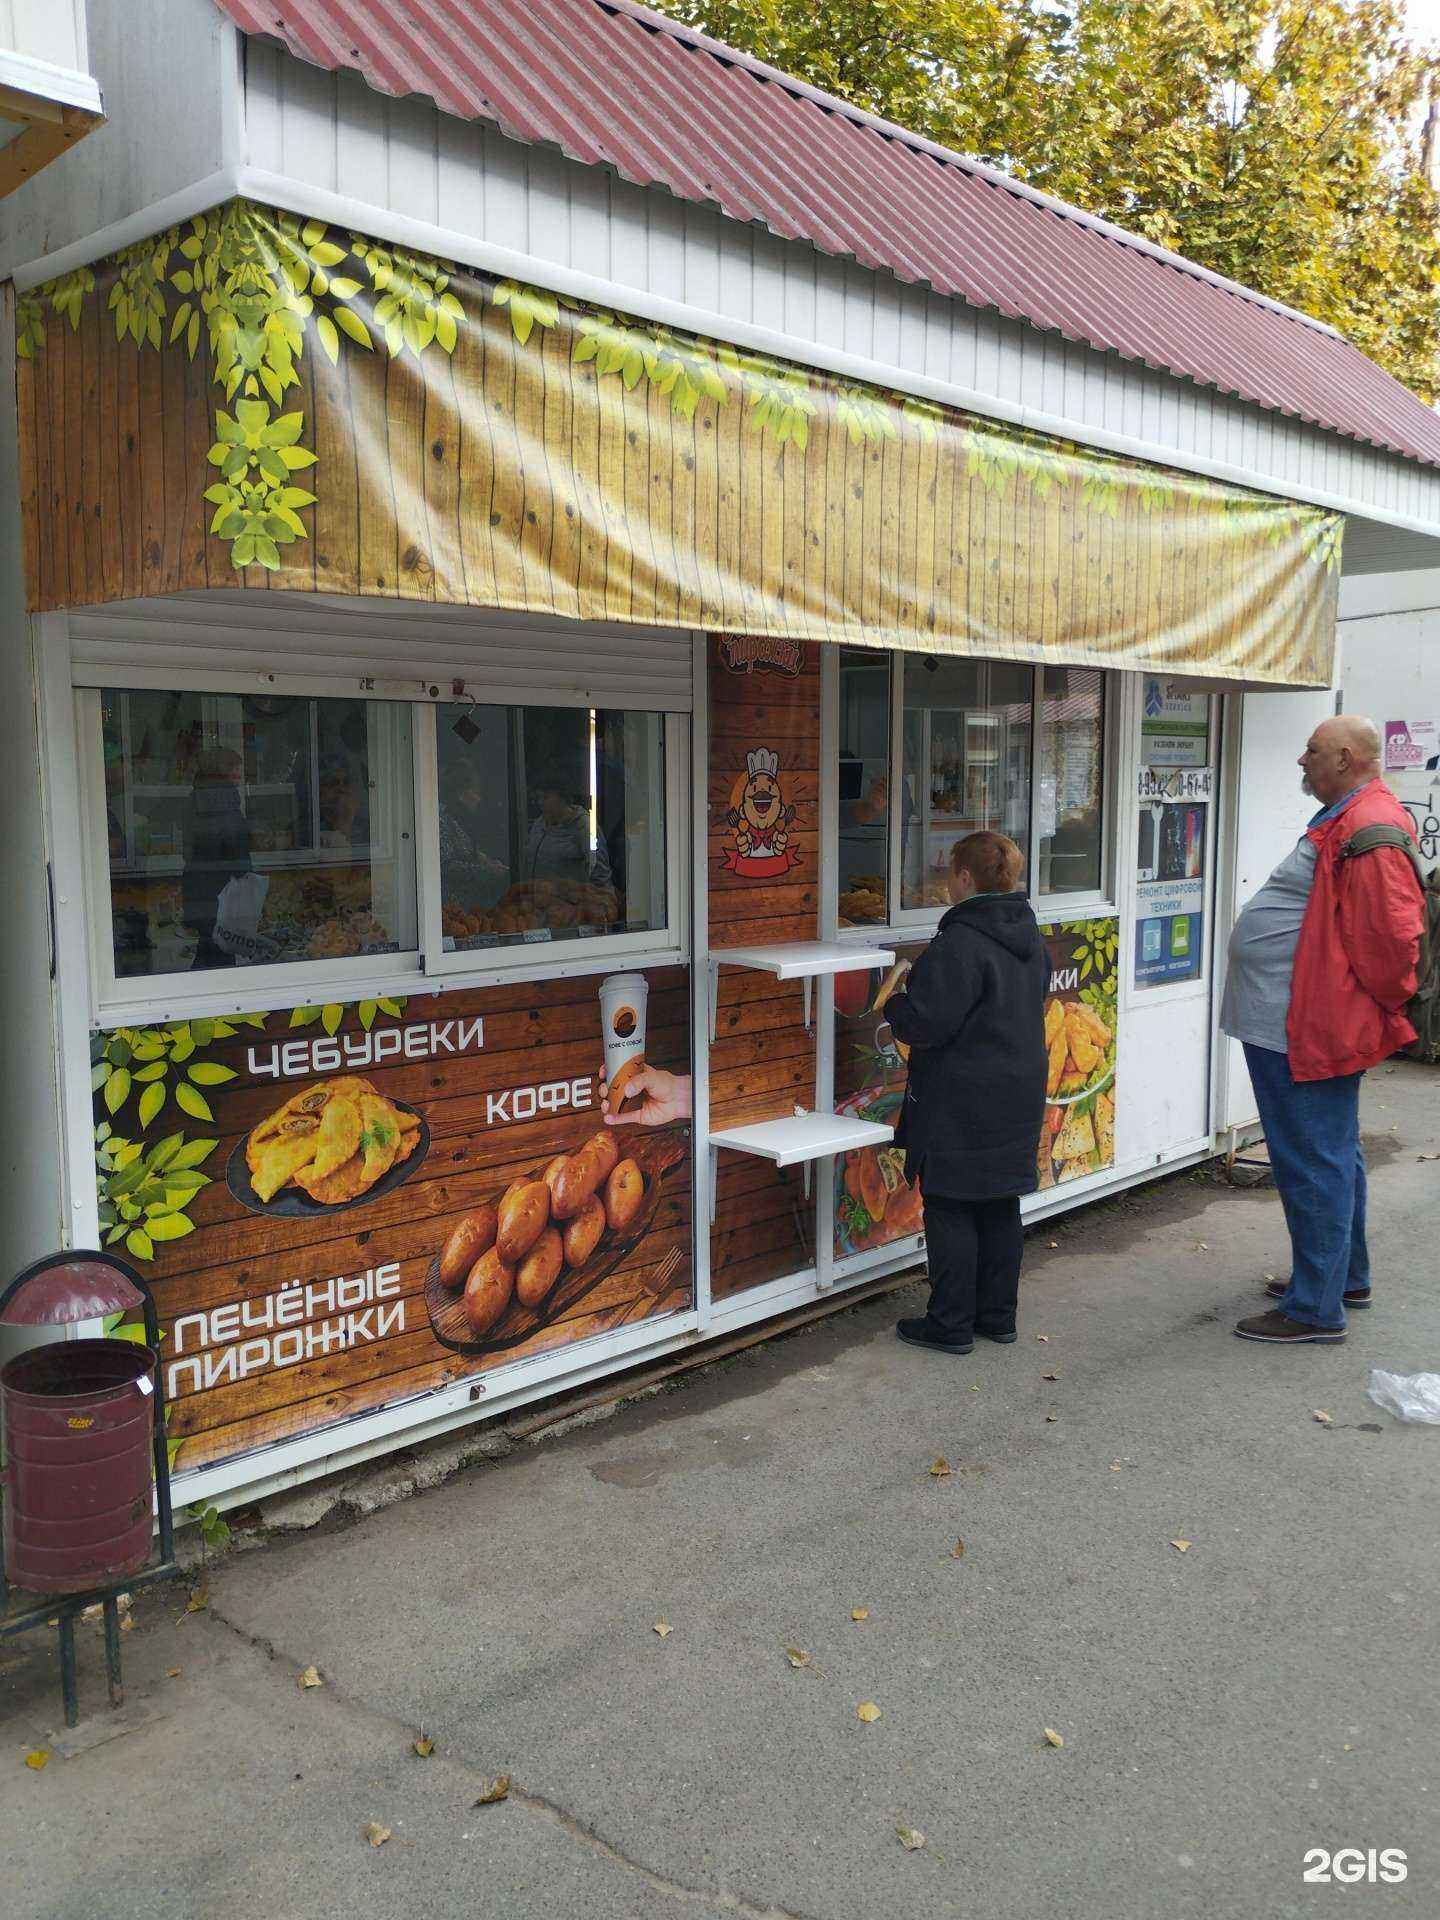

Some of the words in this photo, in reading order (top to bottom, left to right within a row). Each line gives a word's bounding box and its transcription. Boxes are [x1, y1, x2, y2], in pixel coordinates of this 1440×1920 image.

[247, 1018, 485, 1078] ЧЕБУРЕКИ
[486, 1077, 593, 1125] КОФЕ
[174, 1262, 400, 1353] ПЕЧЁНЫЕ
[168, 1300, 405, 1399] ПИРОЖКИ
